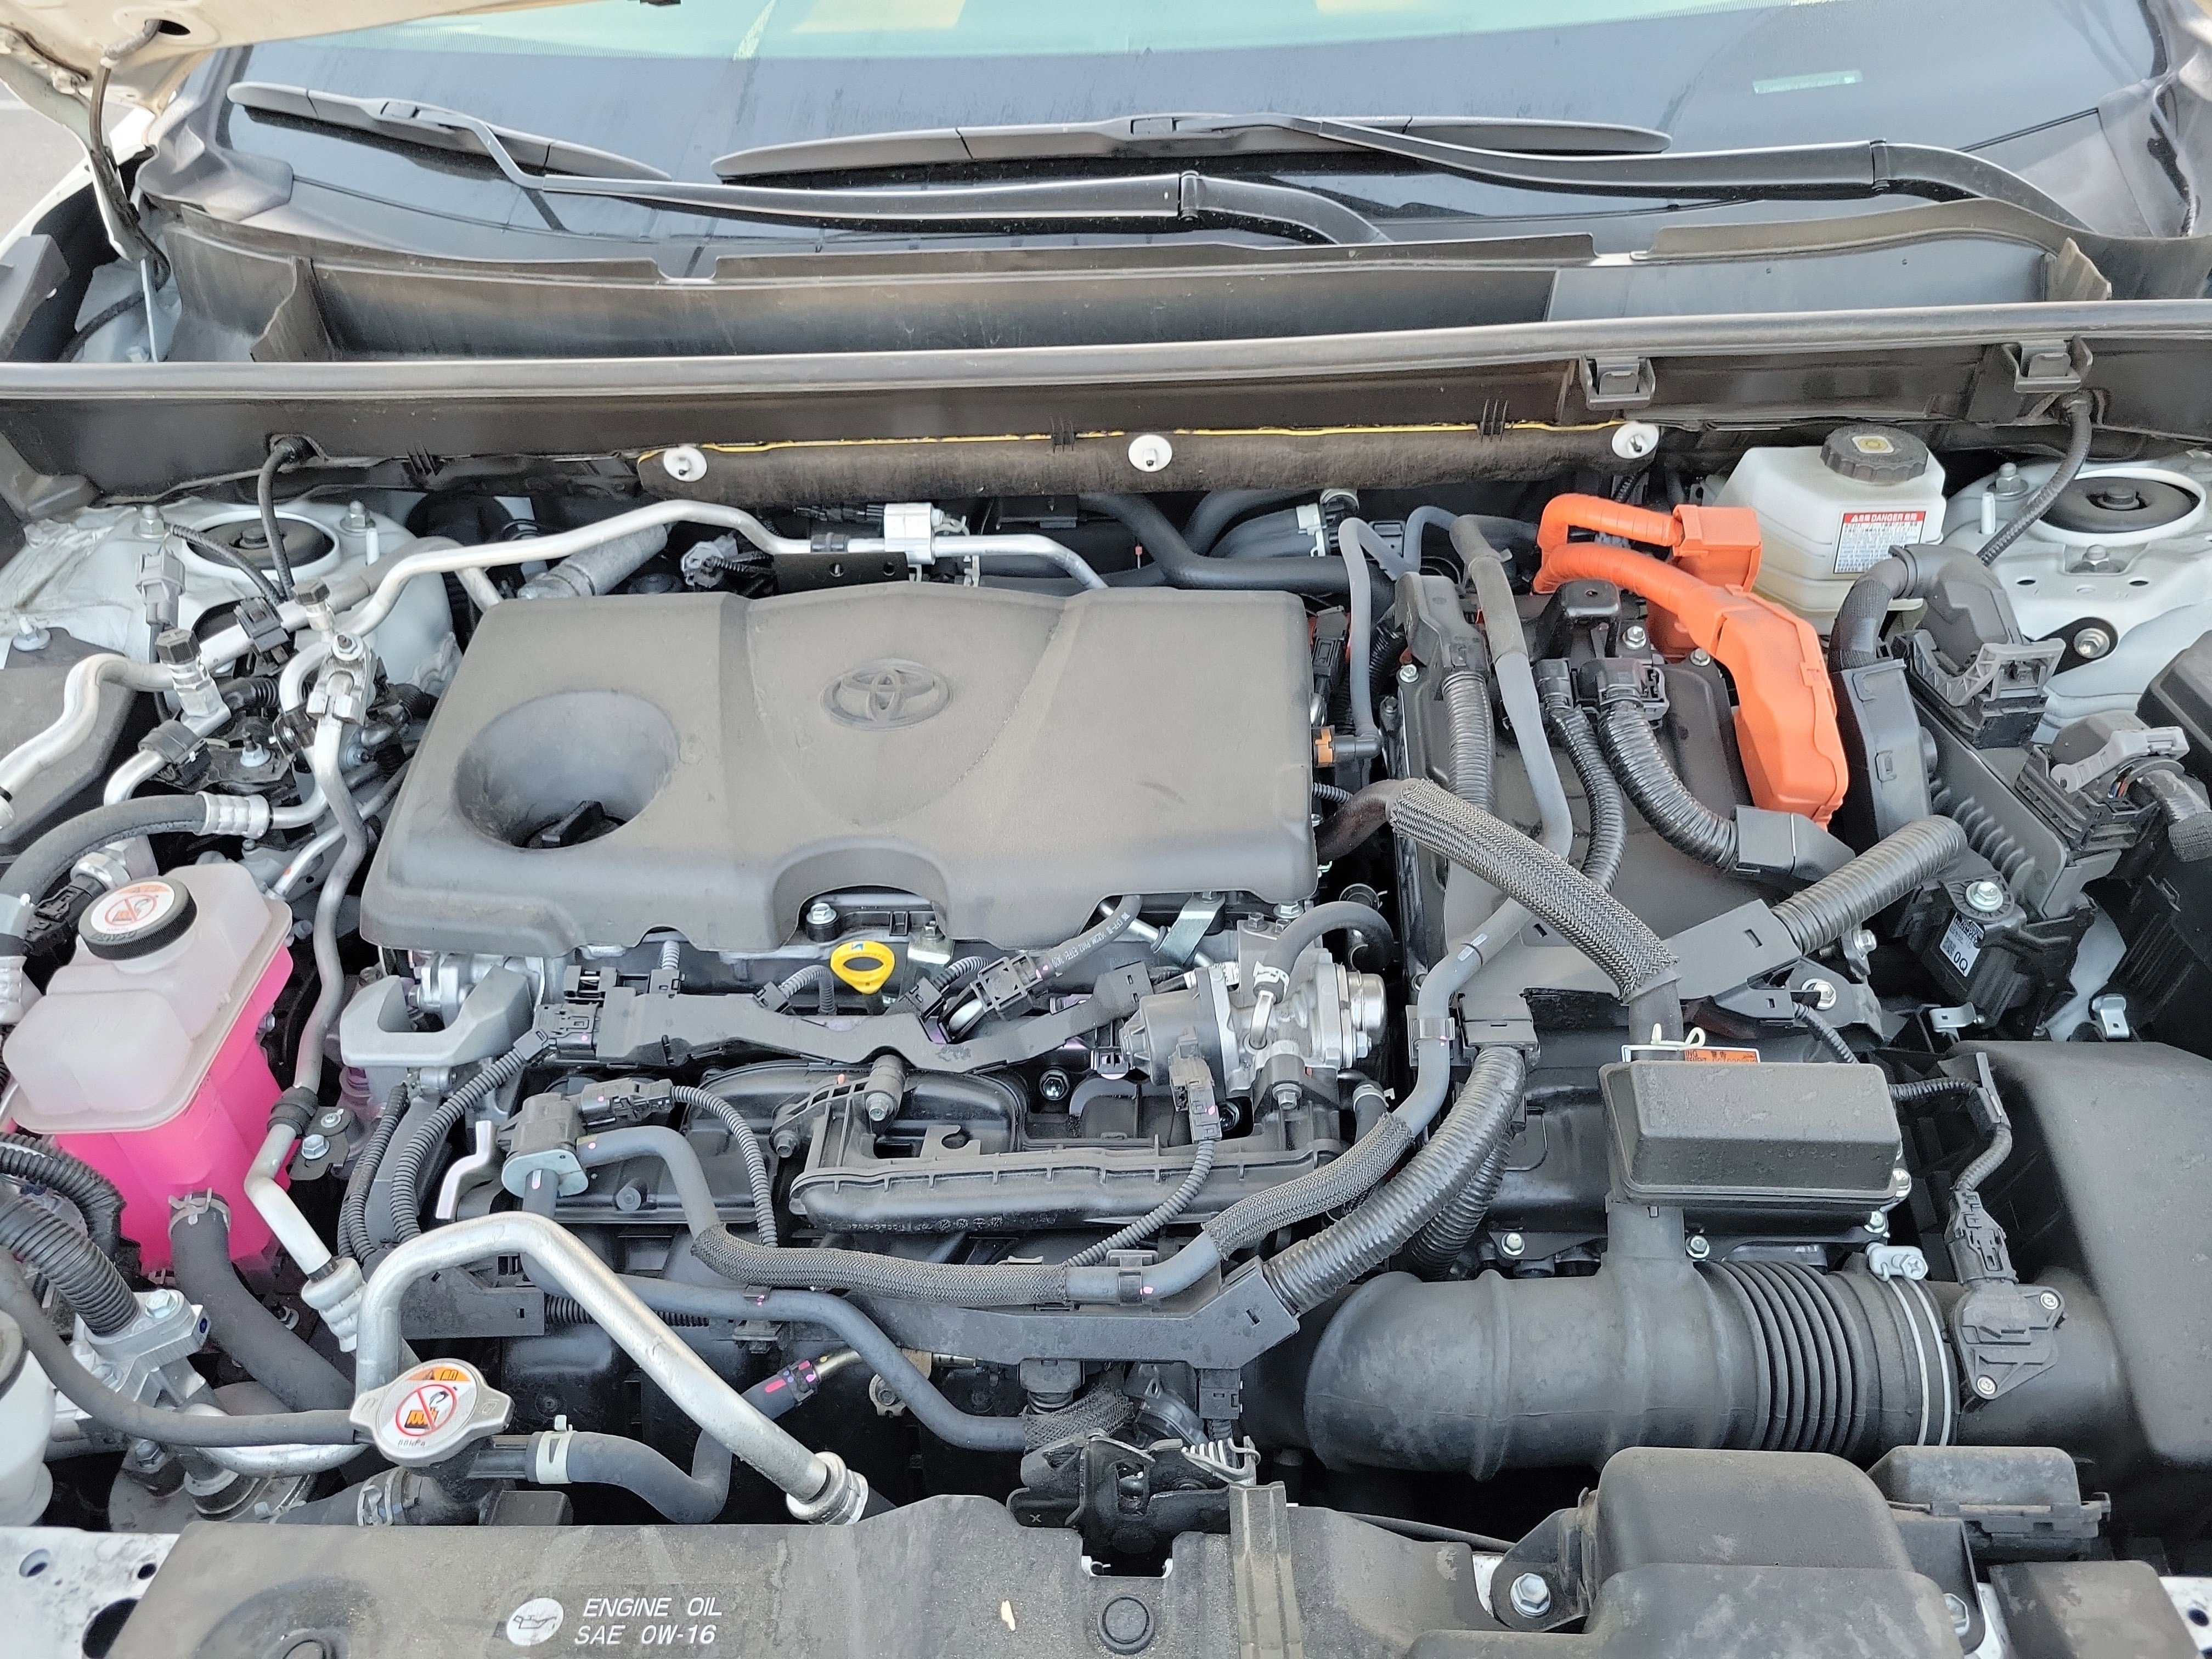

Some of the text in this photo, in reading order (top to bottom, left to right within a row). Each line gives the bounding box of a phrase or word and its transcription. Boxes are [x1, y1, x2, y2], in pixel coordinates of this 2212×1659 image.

[1871, 512, 1903, 523] DANGER
[1961, 918, 1977, 940] TOYOTA
[583, 1597, 722, 1617] ENGINE OIL
[574, 1624, 717, 1645] SAE 0W-16
